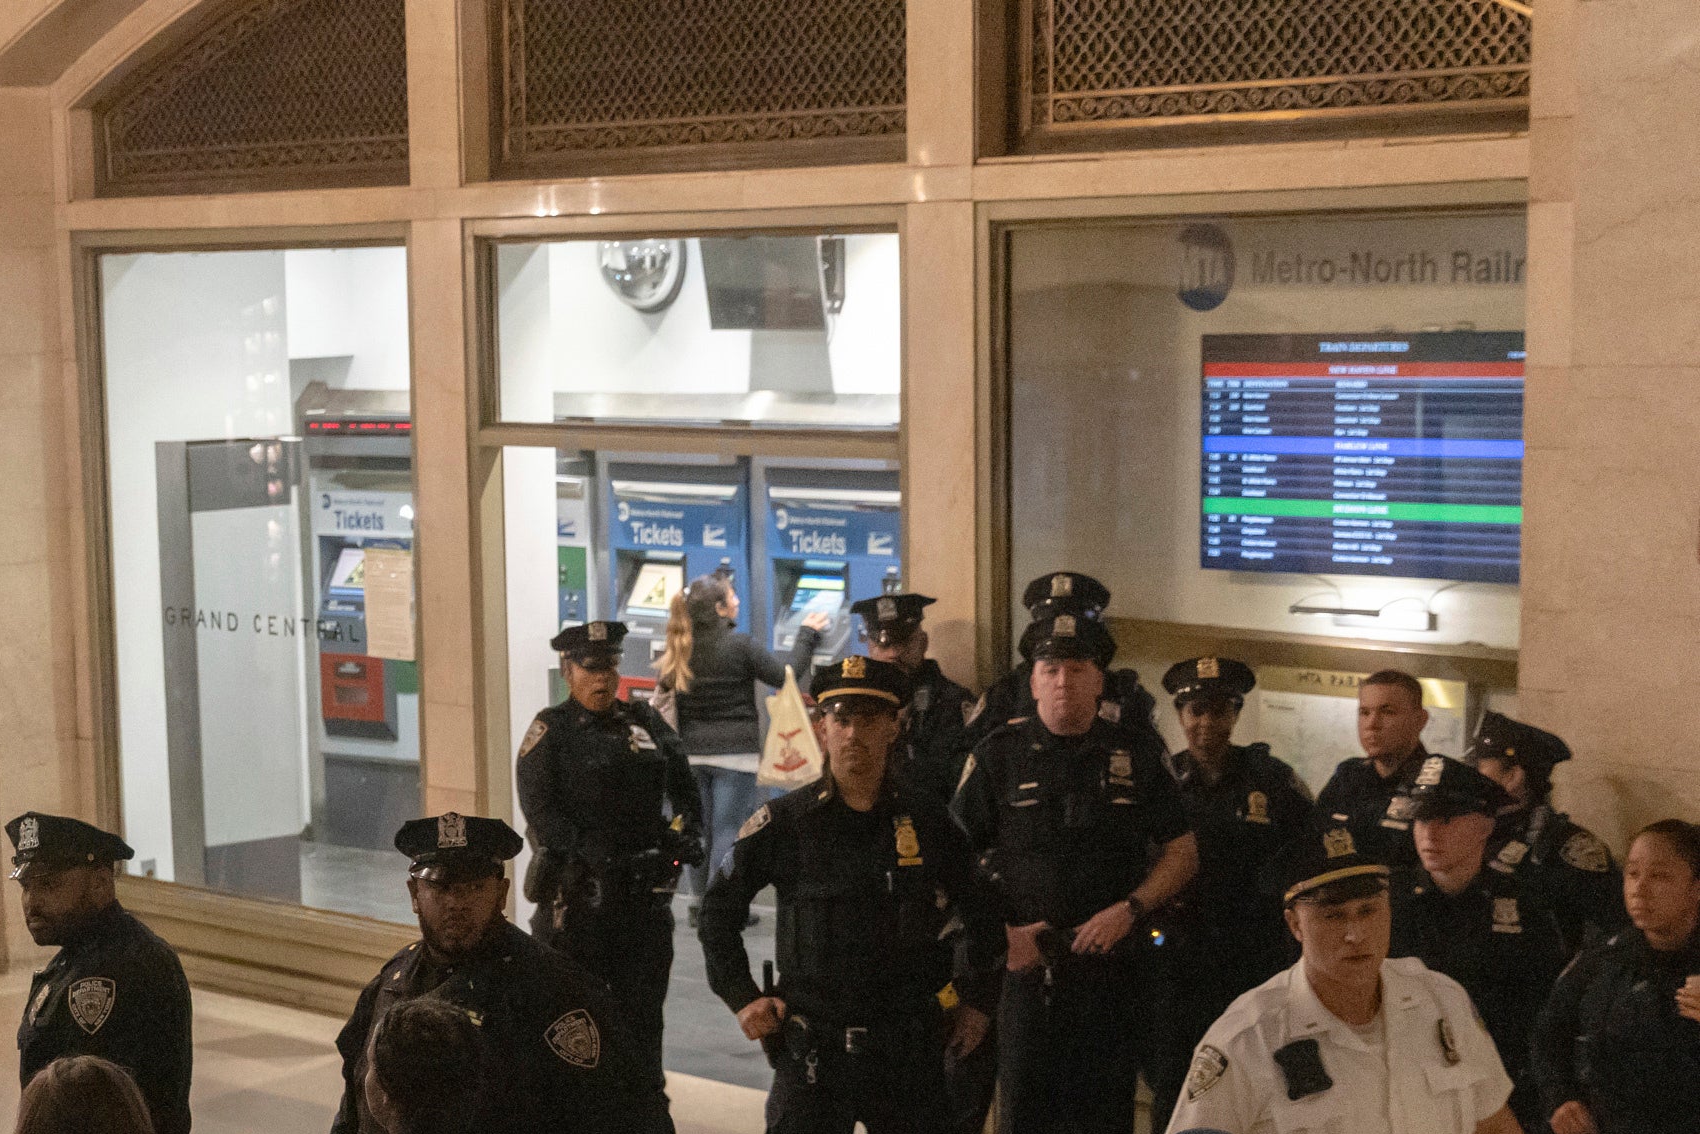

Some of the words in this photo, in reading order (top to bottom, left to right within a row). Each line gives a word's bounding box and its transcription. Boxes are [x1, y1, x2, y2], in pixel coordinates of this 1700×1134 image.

[1252, 250, 1439, 284] Metro-North
[1452, 249, 1526, 284] Railr
[334, 510, 384, 531] Tickets
[631, 521, 684, 547] Tickets
[789, 529, 848, 556] Tickets
[164, 606, 239, 632] GRAND
[253, 614, 361, 643] CENTRAL
